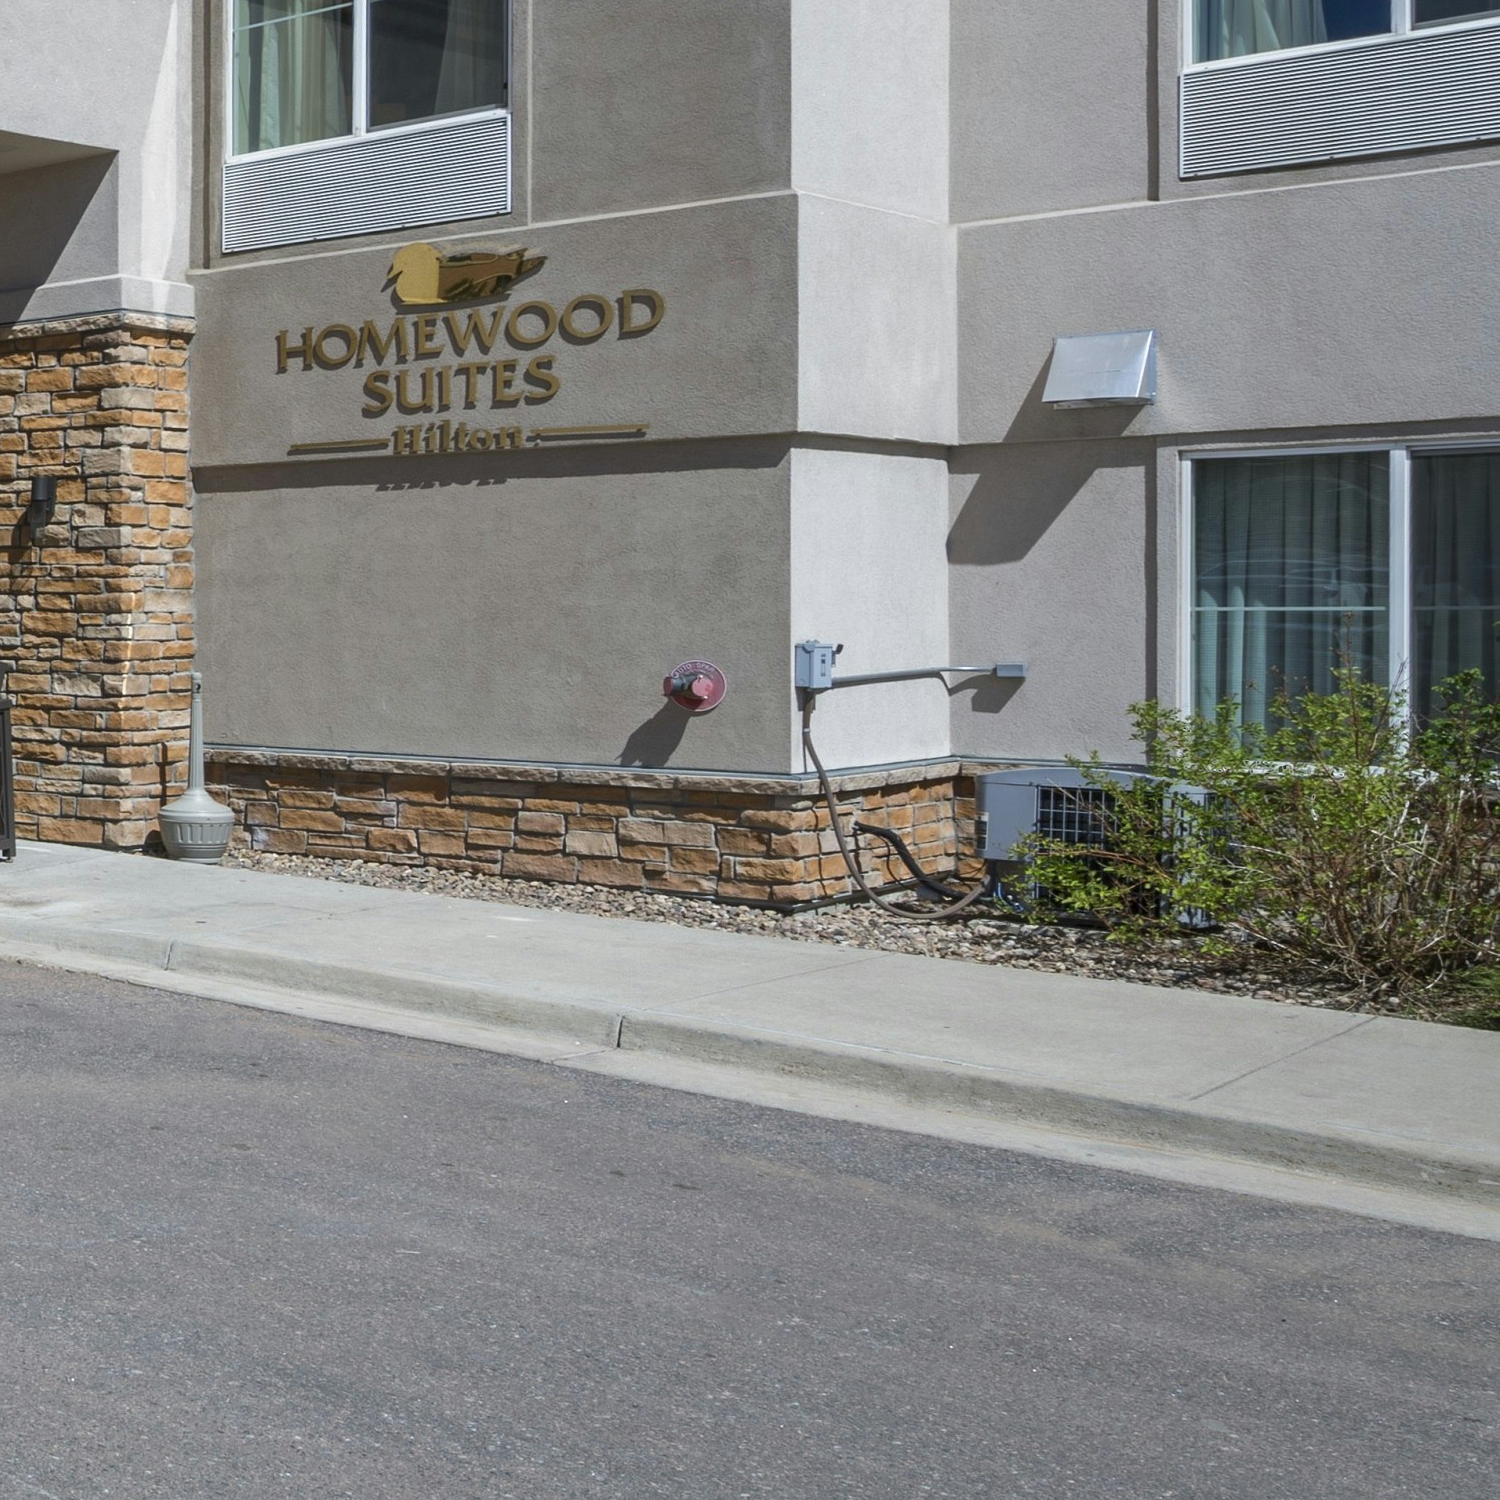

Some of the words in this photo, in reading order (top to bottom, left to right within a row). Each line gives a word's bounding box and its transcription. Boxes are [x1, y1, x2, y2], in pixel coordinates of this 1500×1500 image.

[276, 288, 666, 373] HOMEWOOD
[362, 354, 561, 414] SUITES
[393, 419, 524, 455] Hilton
